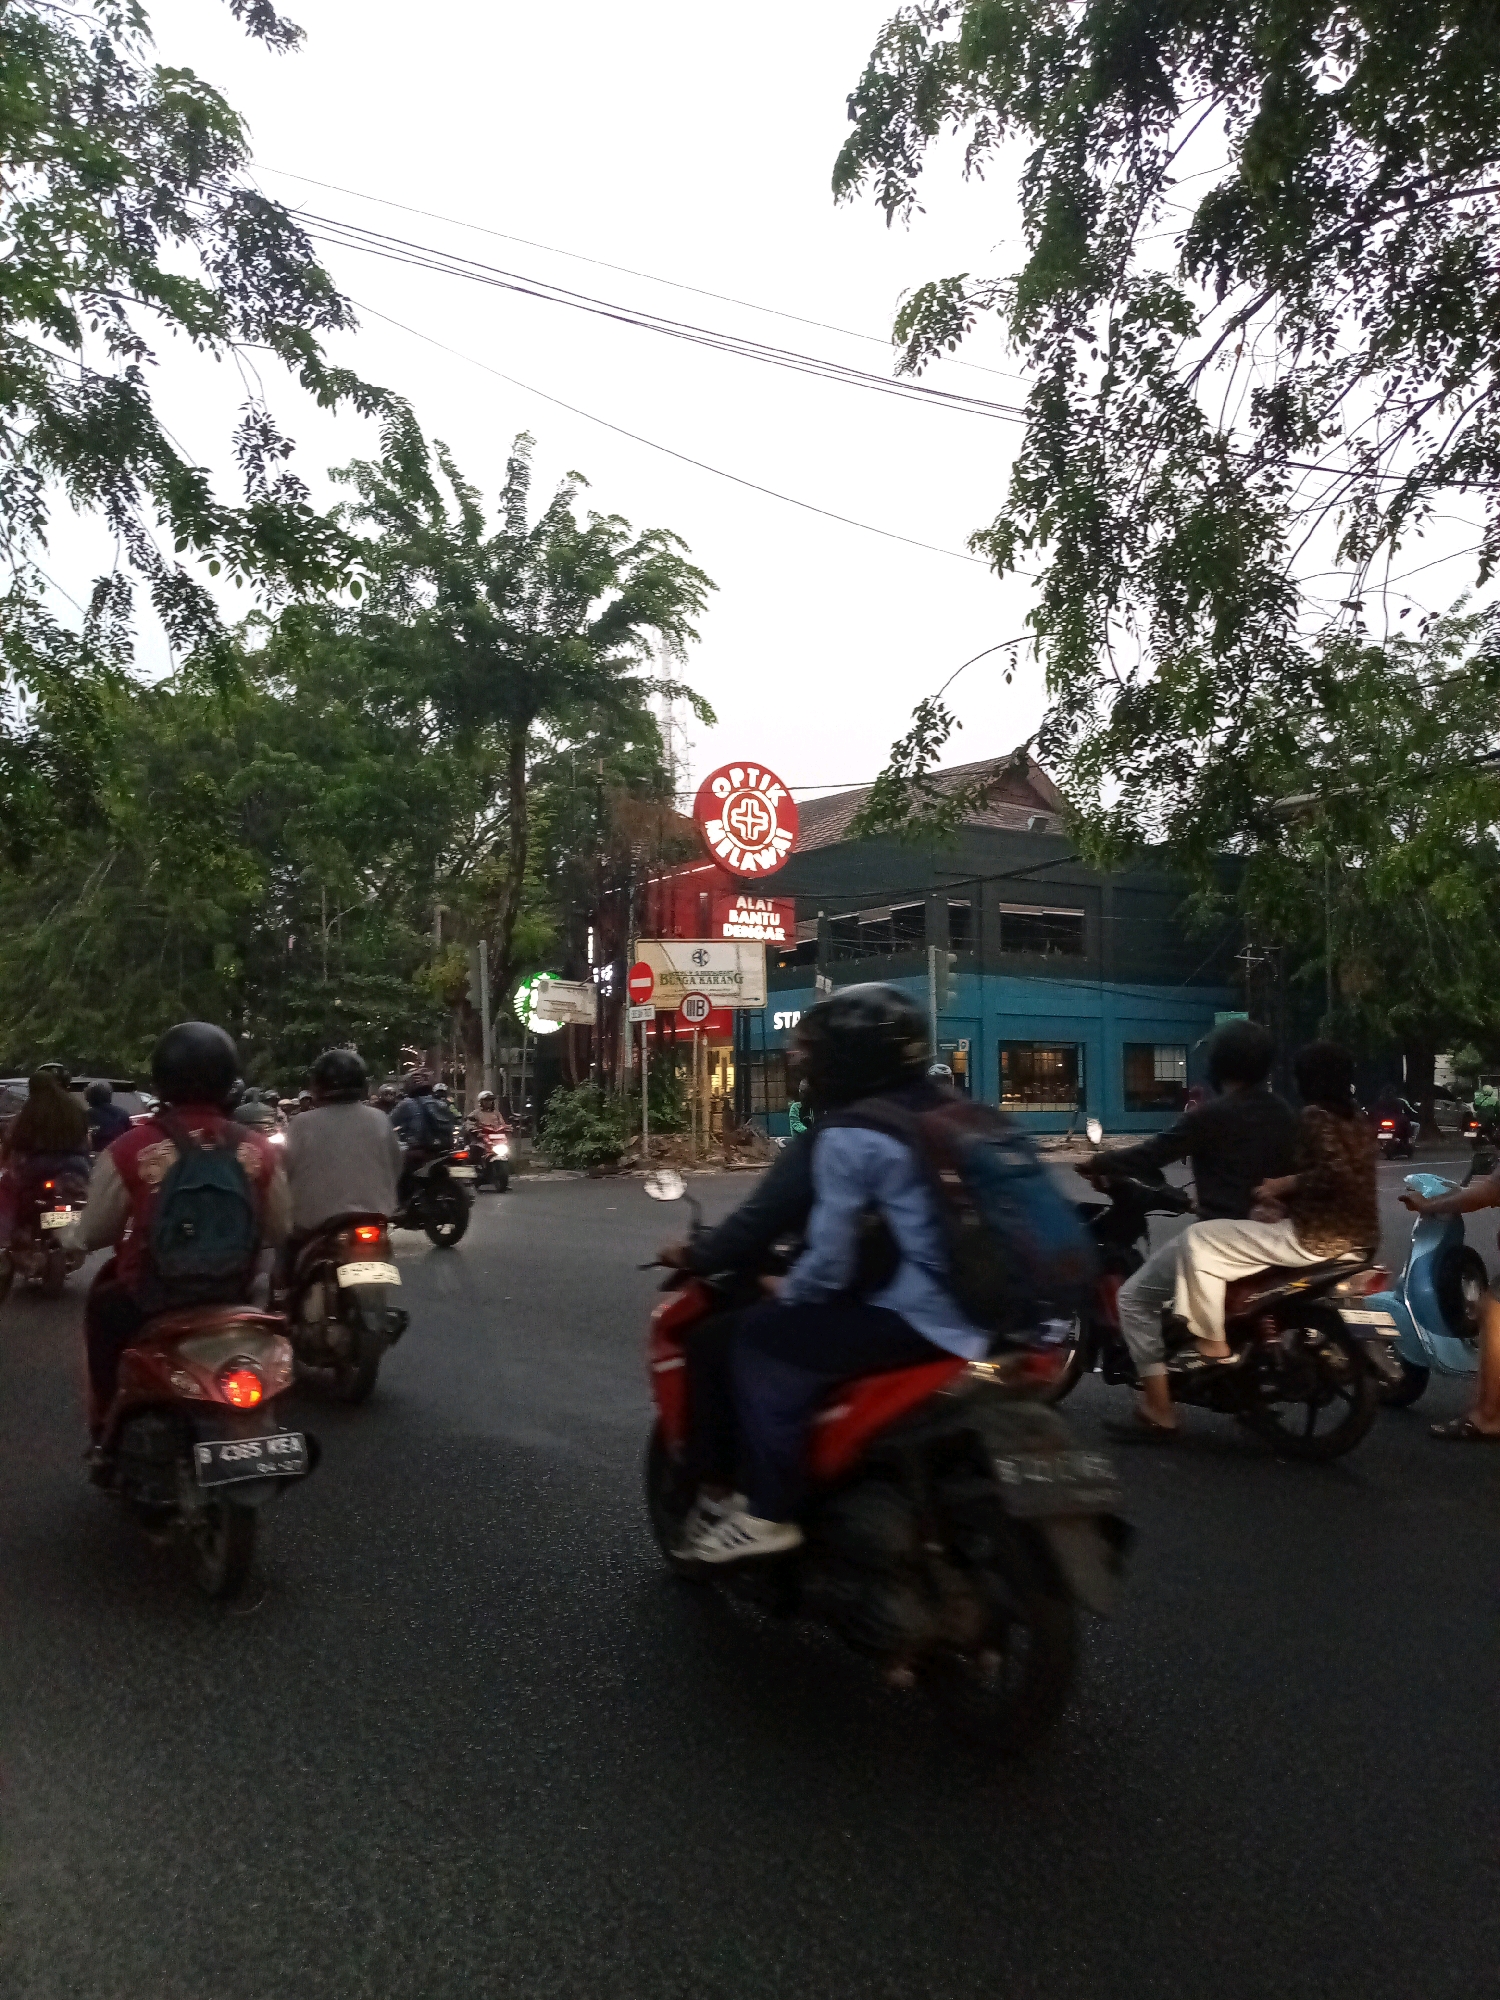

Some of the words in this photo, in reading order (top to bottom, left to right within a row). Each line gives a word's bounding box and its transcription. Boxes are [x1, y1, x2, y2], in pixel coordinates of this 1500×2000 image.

[711, 767, 788, 808] OPTIK
[704, 819, 794, 872] MELAWAI
[736, 896, 774, 911] ALAT
[728, 910, 781, 926] BANTU
[722, 923, 786, 941] DENGAR
[659, 973, 697, 985] BUNGA
[699, 972, 745, 985] KARANG
